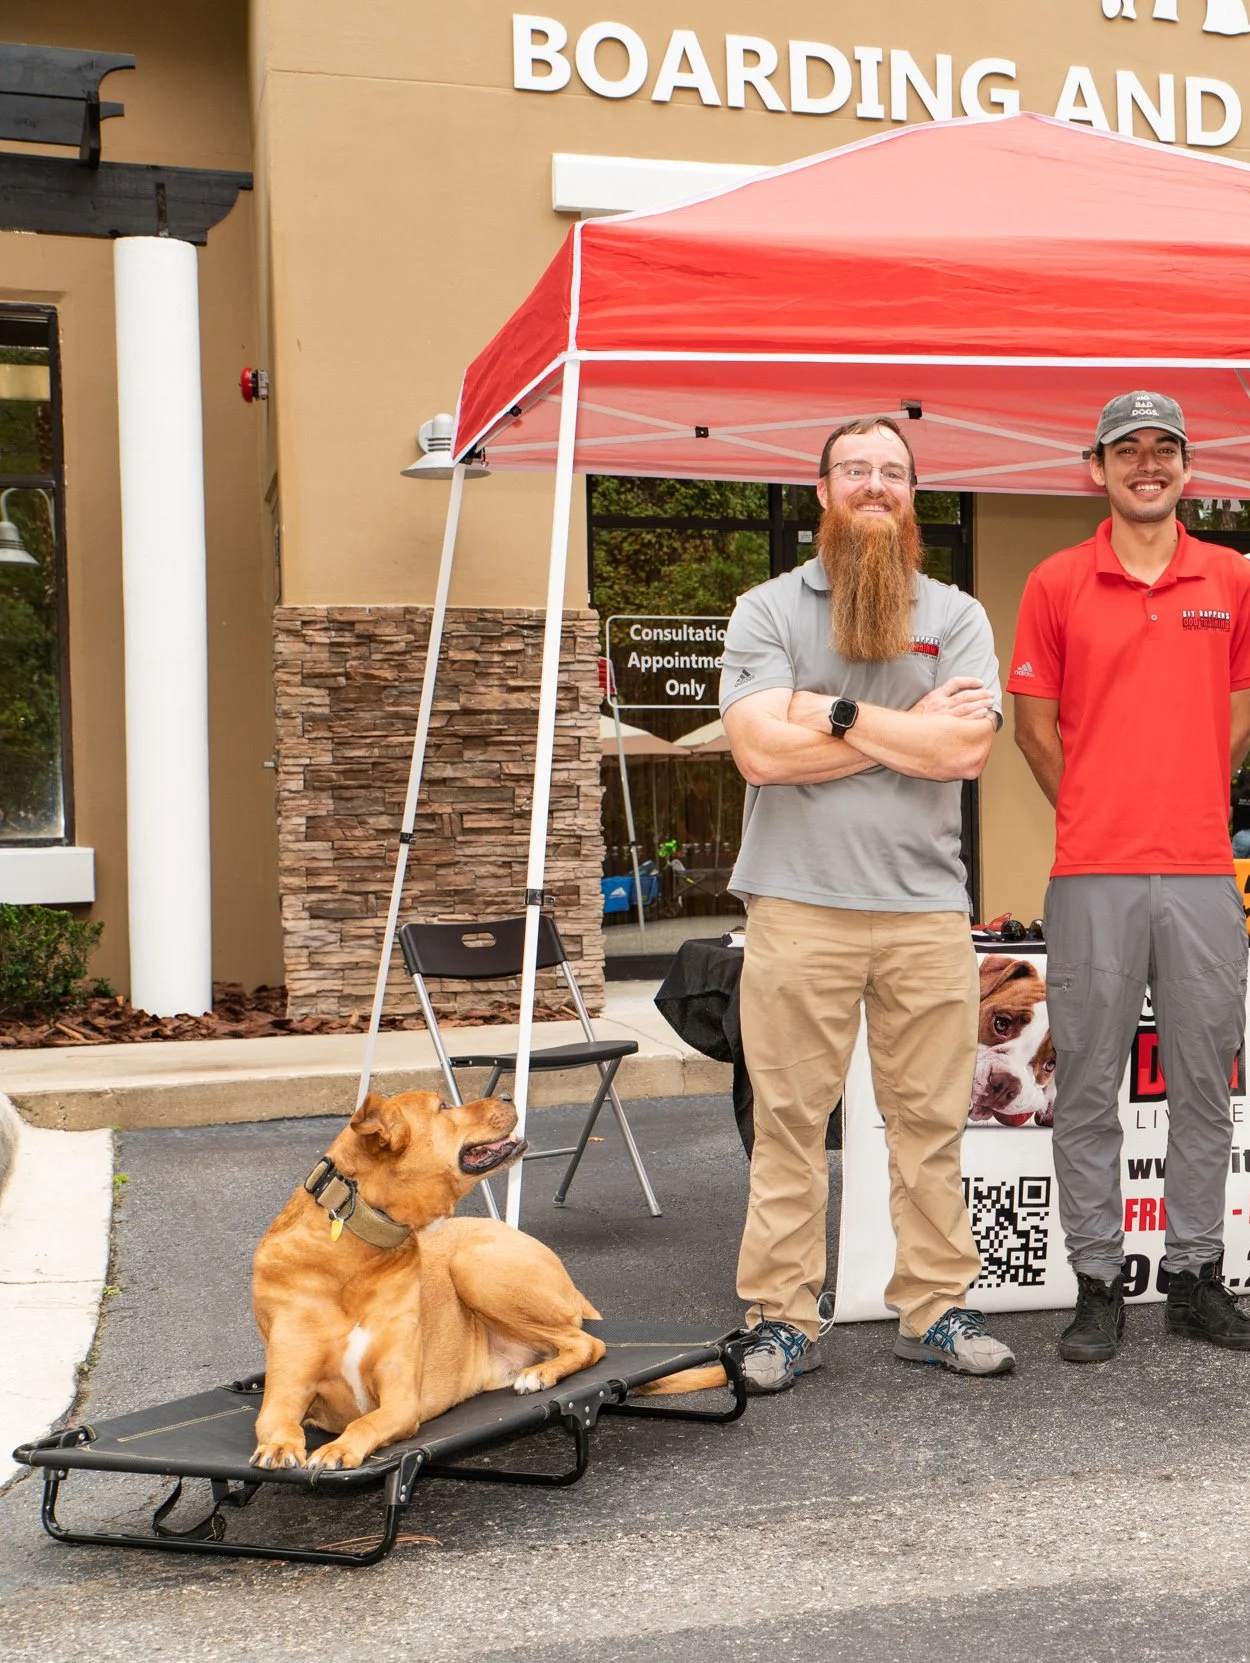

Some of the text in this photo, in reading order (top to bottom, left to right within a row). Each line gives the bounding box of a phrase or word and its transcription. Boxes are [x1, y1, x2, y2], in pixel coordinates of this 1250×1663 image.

[512, 13, 1020, 120] BOARDING
[1053, 65, 1243, 146] AND
[1182, 609, 1231, 620] SIT HAPPENS
[629, 624, 727, 641] Consultatio
[627, 652, 724, 673] Appointme
[665, 679, 706, 700] Only
